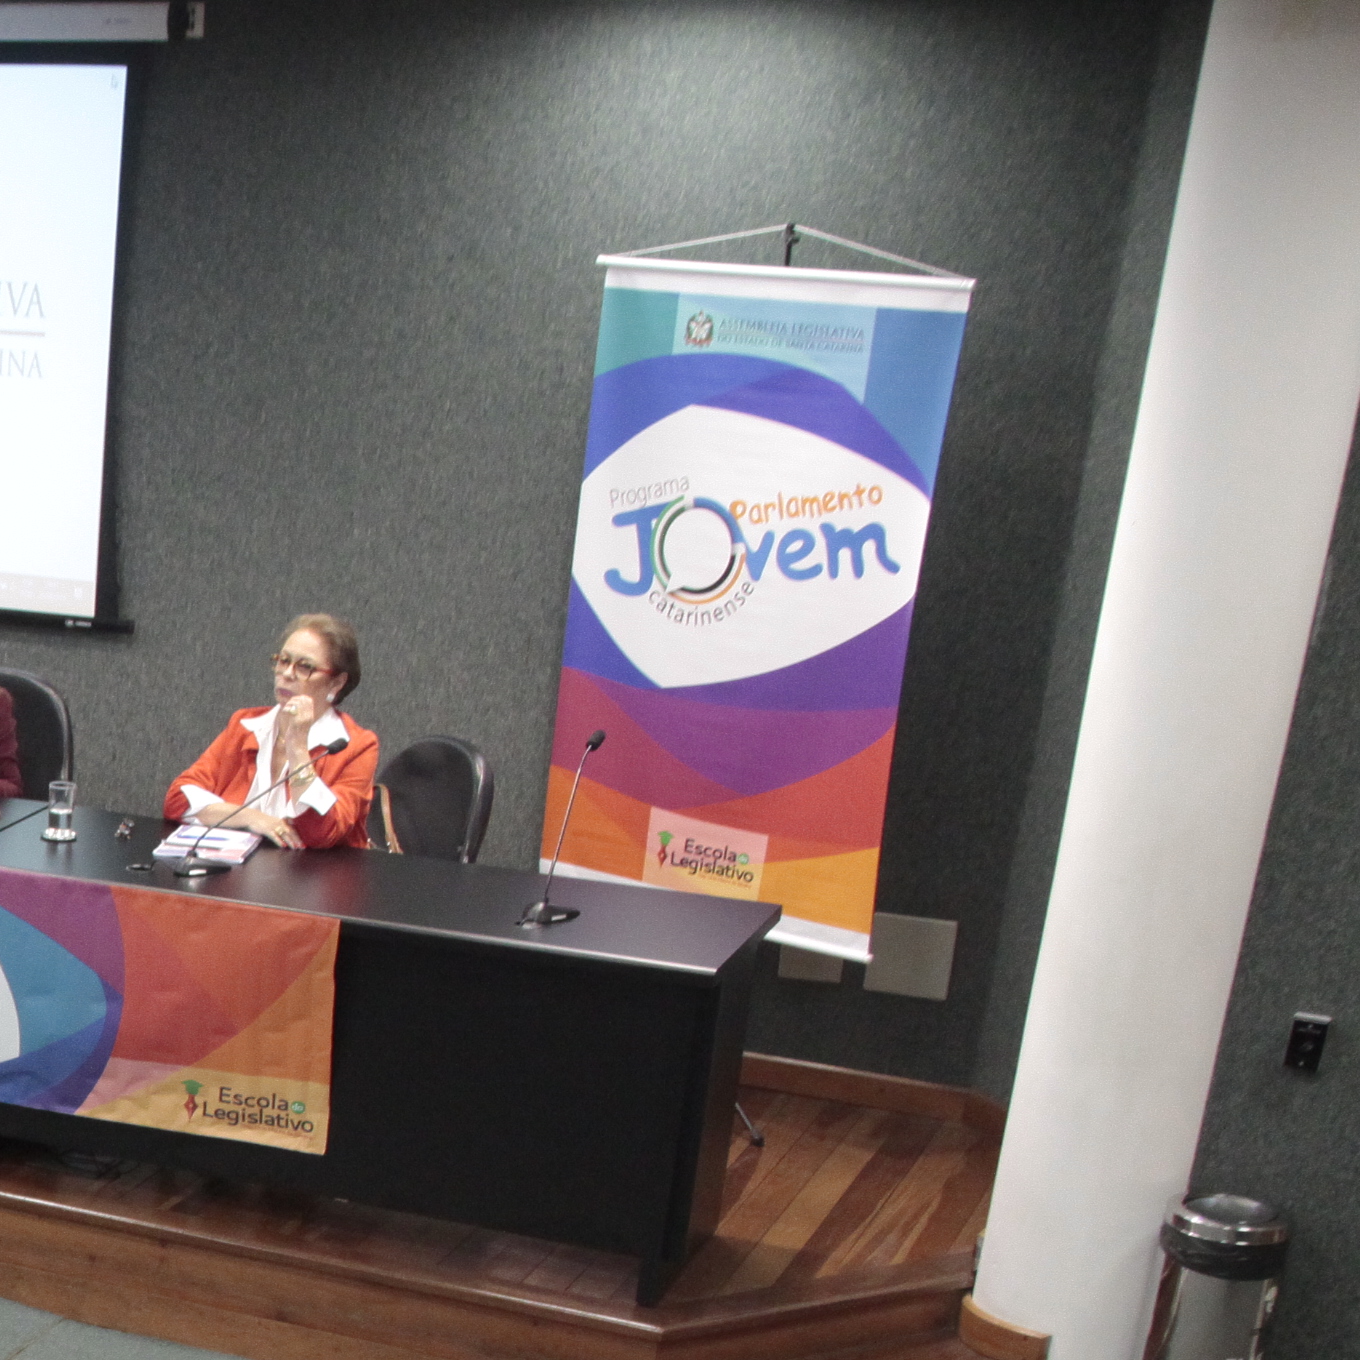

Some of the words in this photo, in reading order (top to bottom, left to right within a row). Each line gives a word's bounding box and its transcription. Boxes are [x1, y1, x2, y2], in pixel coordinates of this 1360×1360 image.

[609, 475, 690, 509] Programa
[729, 483, 883, 525] Parlamento
[648, 581, 755, 627] catarinense
[684, 838, 737, 862] Escola
[670, 851, 754, 883] Legislativo
[218, 1086, 289, 1111] Escola
[202, 1101, 314, 1133] Legislativo
